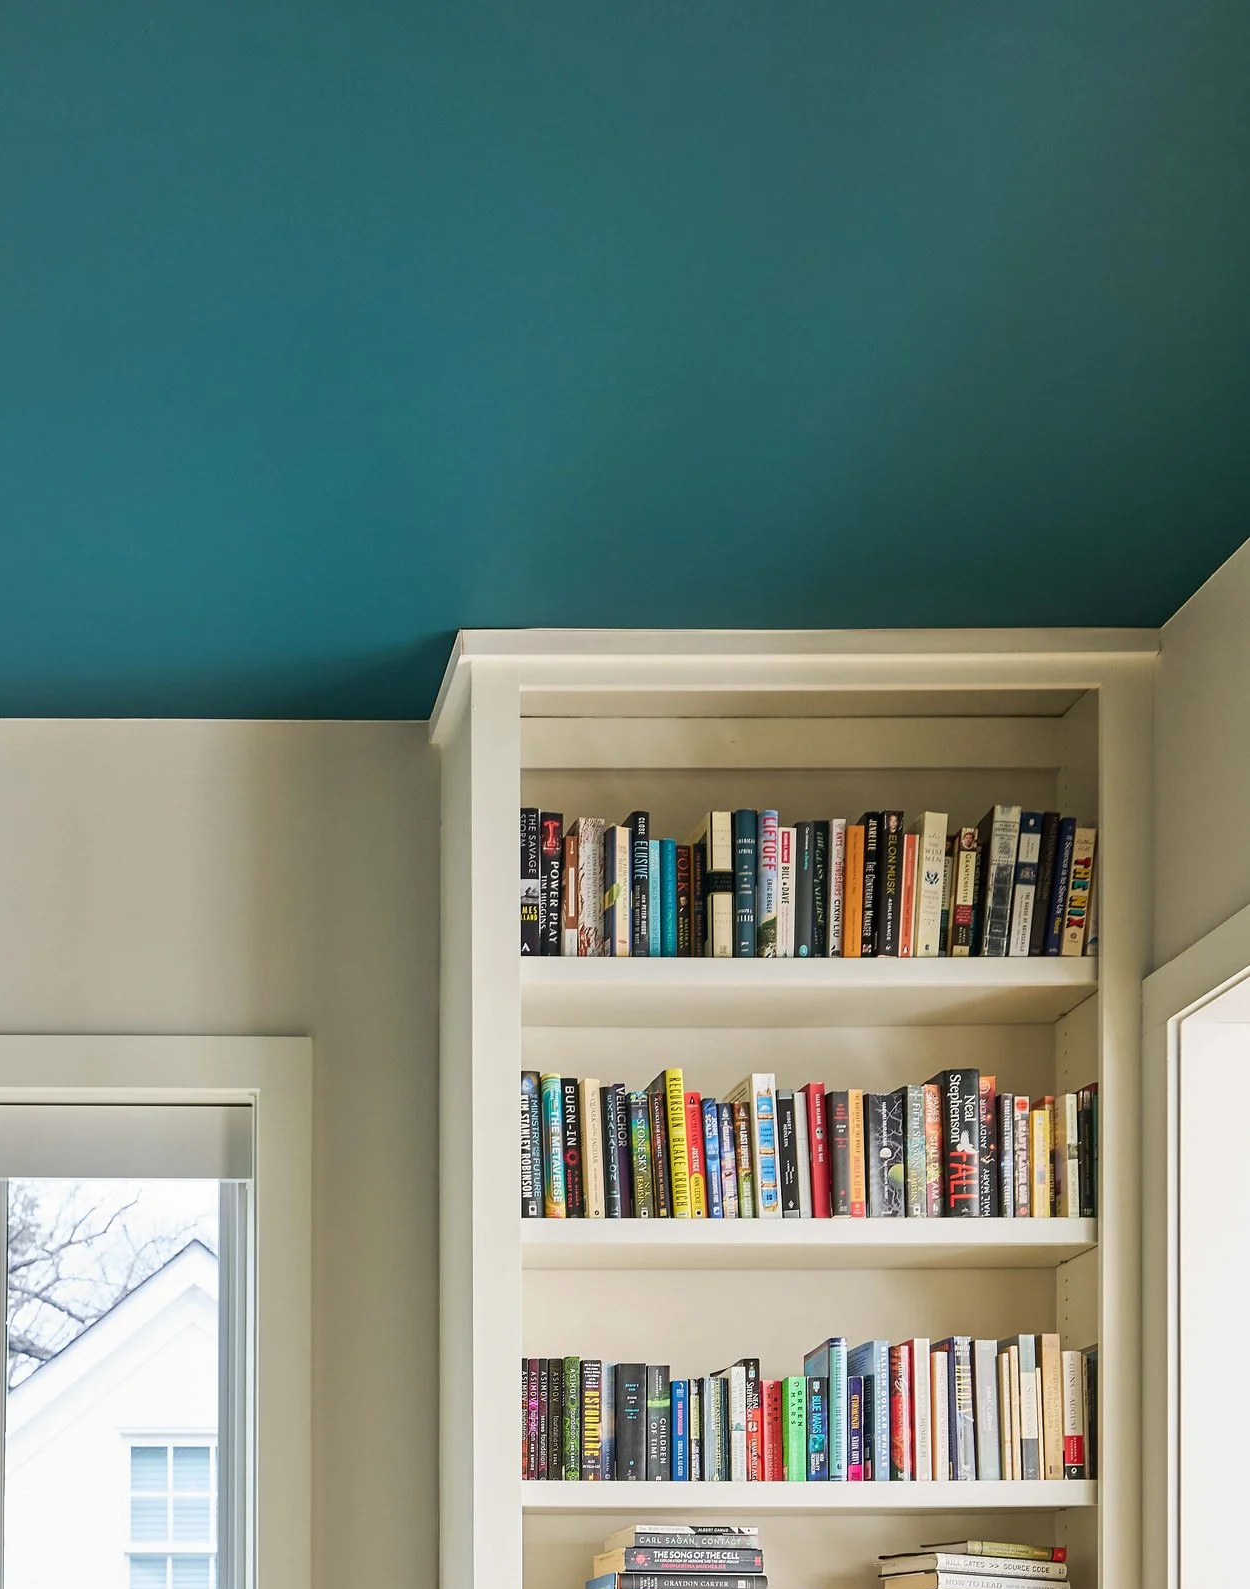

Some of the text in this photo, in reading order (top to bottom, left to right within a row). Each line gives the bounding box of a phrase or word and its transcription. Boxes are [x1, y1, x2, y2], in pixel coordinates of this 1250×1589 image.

[633, 816, 649, 880] CLOSE ELUSIVE
[762, 816, 777, 872] LIFTOFF
[886, 834, 897, 894] ELON MUSK
[548, 860, 560, 945] POWER PLAY
[766, 893, 774, 914] BERGER
[1066, 856, 1092, 929] THE NIX
[564, 1085, 577, 1146] BURN-IN
[946, 1074, 962, 1143] Stephenson
[964, 1095, 976, 1122] Neal
[636, 1118, 649, 1172] STONE SKY
[668, 1076, 689, 1207] RECURSION BLAKE CROUCH
[950, 1150, 978, 1208] FALL
[569, 1368, 577, 1399] ASIMOV
[584, 1390, 599, 1457] ASTOUNDING
[649, 1422, 659, 1460] OF TIME
[658, 1417, 668, 1464] CHILDREN
[639, 1536, 662, 1544] CARL
[701, 1537, 742, 1546] CONTACT
[670, 1551, 693, 1559] SONG
[694, 1551, 705, 1559] OF
[721, 1552, 740, 1560] CELL
